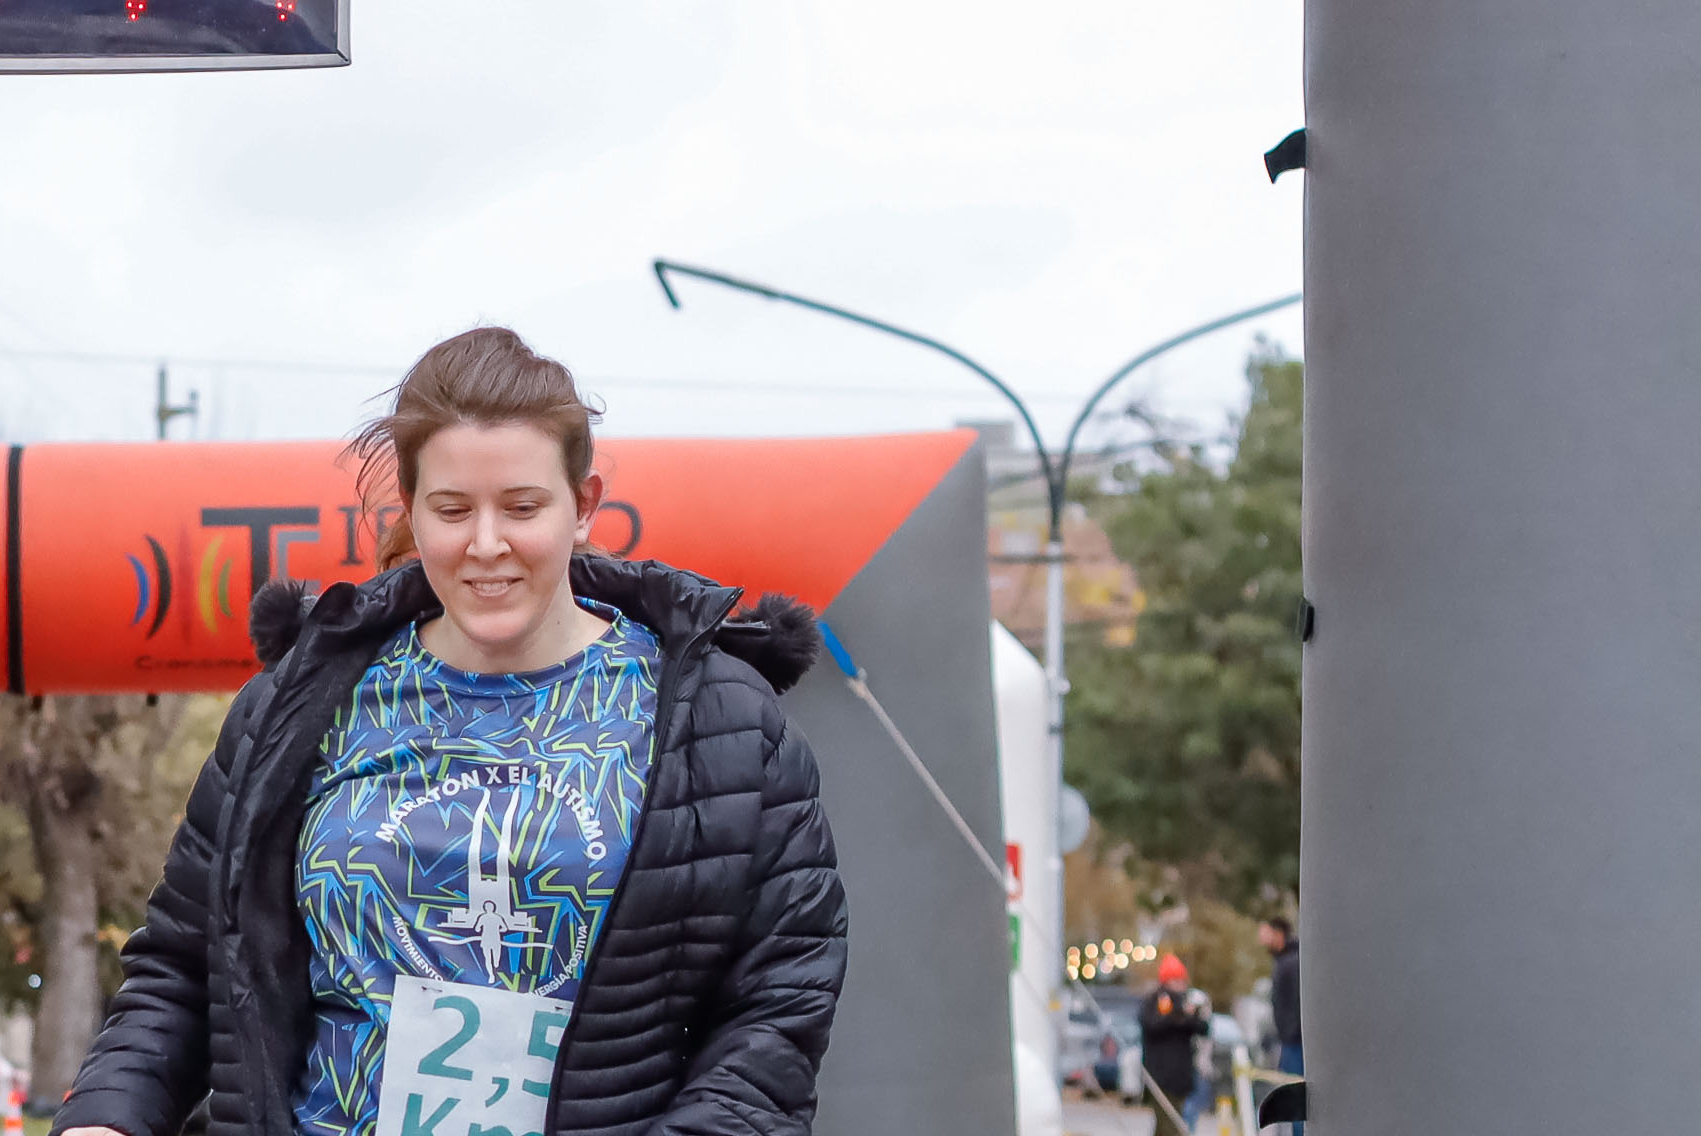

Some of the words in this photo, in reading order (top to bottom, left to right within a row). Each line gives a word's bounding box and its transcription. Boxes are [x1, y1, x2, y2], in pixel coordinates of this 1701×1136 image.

[484, 766, 503, 785] X
[508, 766, 532, 785] EL
[536, 772, 607, 861] AUTISMO
[393, 916, 444, 982] MOVIMIENTO
[565, 924, 589, 978] POSITIVA
[417, 995, 572, 1108] 2,5
